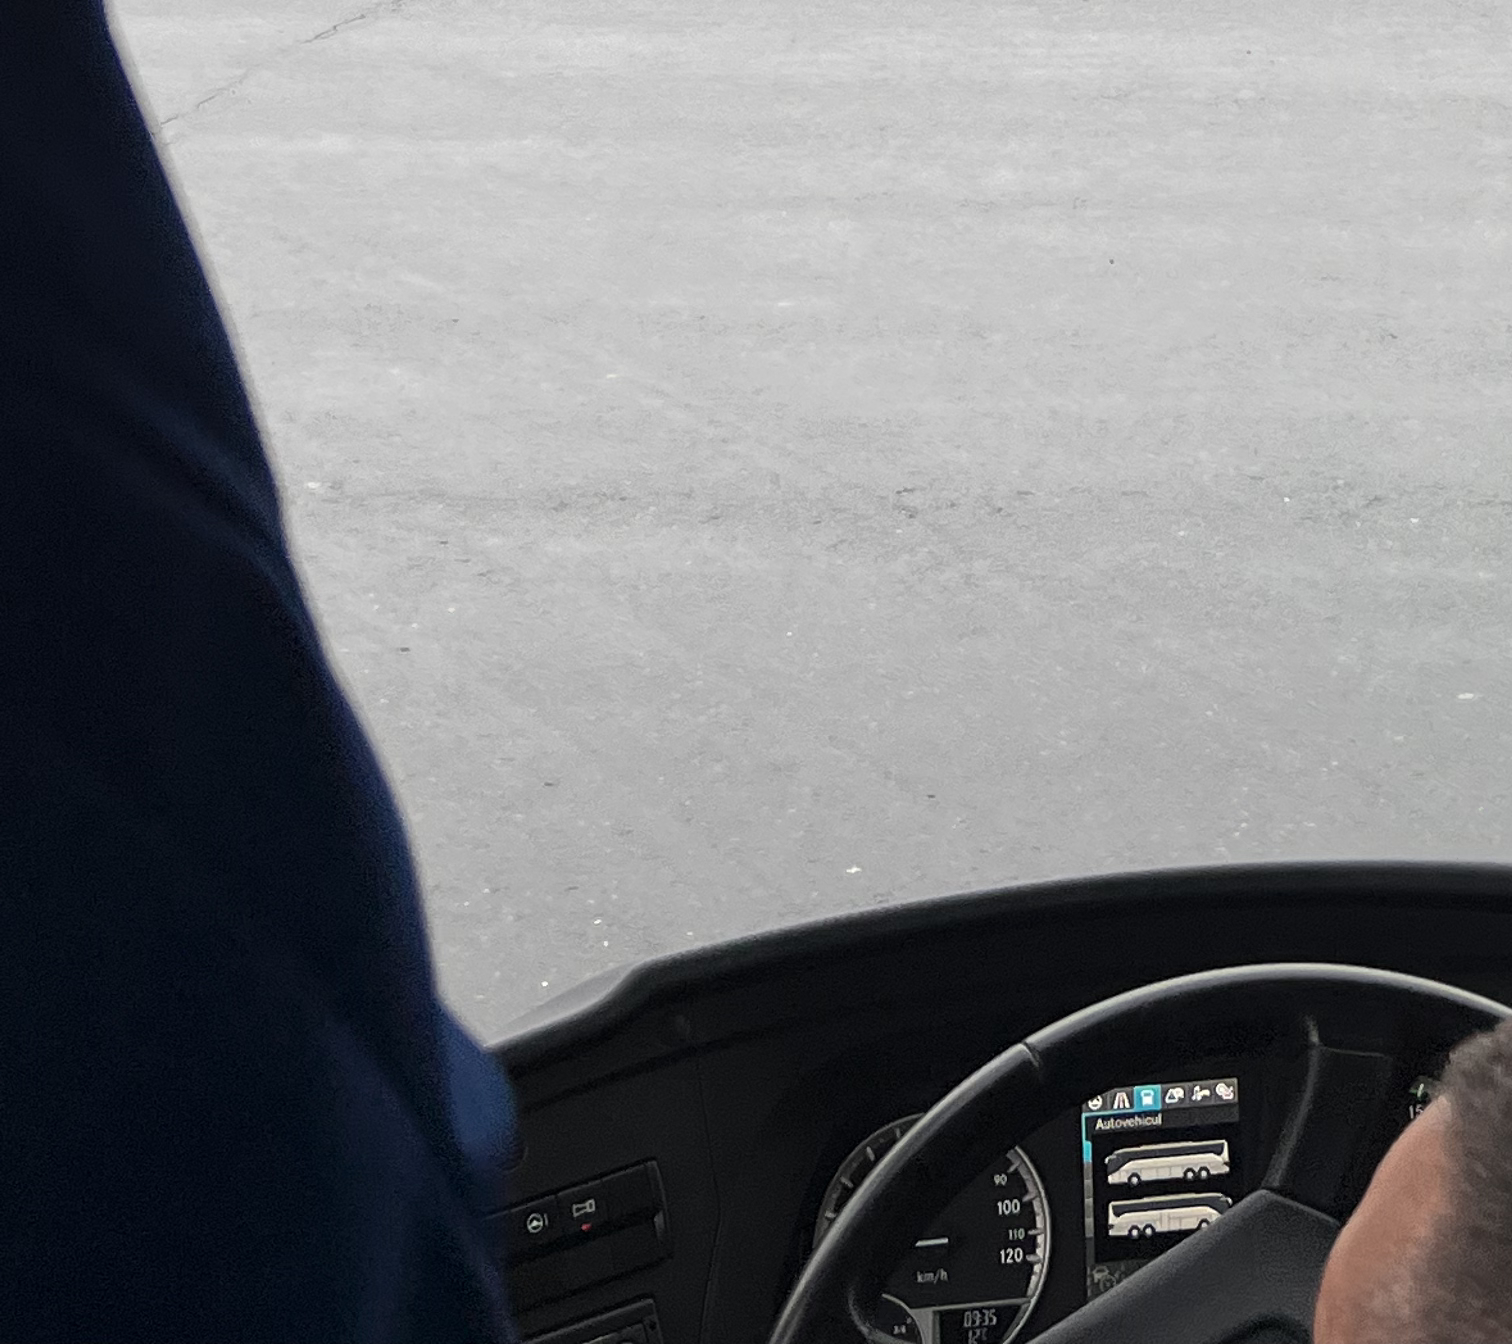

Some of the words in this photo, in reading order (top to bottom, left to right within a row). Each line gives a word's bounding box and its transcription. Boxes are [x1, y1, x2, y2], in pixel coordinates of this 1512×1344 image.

[1095, 1113, 1163, 1131] Autovehicul
[997, 1199, 1021, 1216] 100
[1008, 1228, 1026, 1240] 110
[1000, 1248, 1023, 1264] 120
[916, 1268, 949, 1285] km/h
